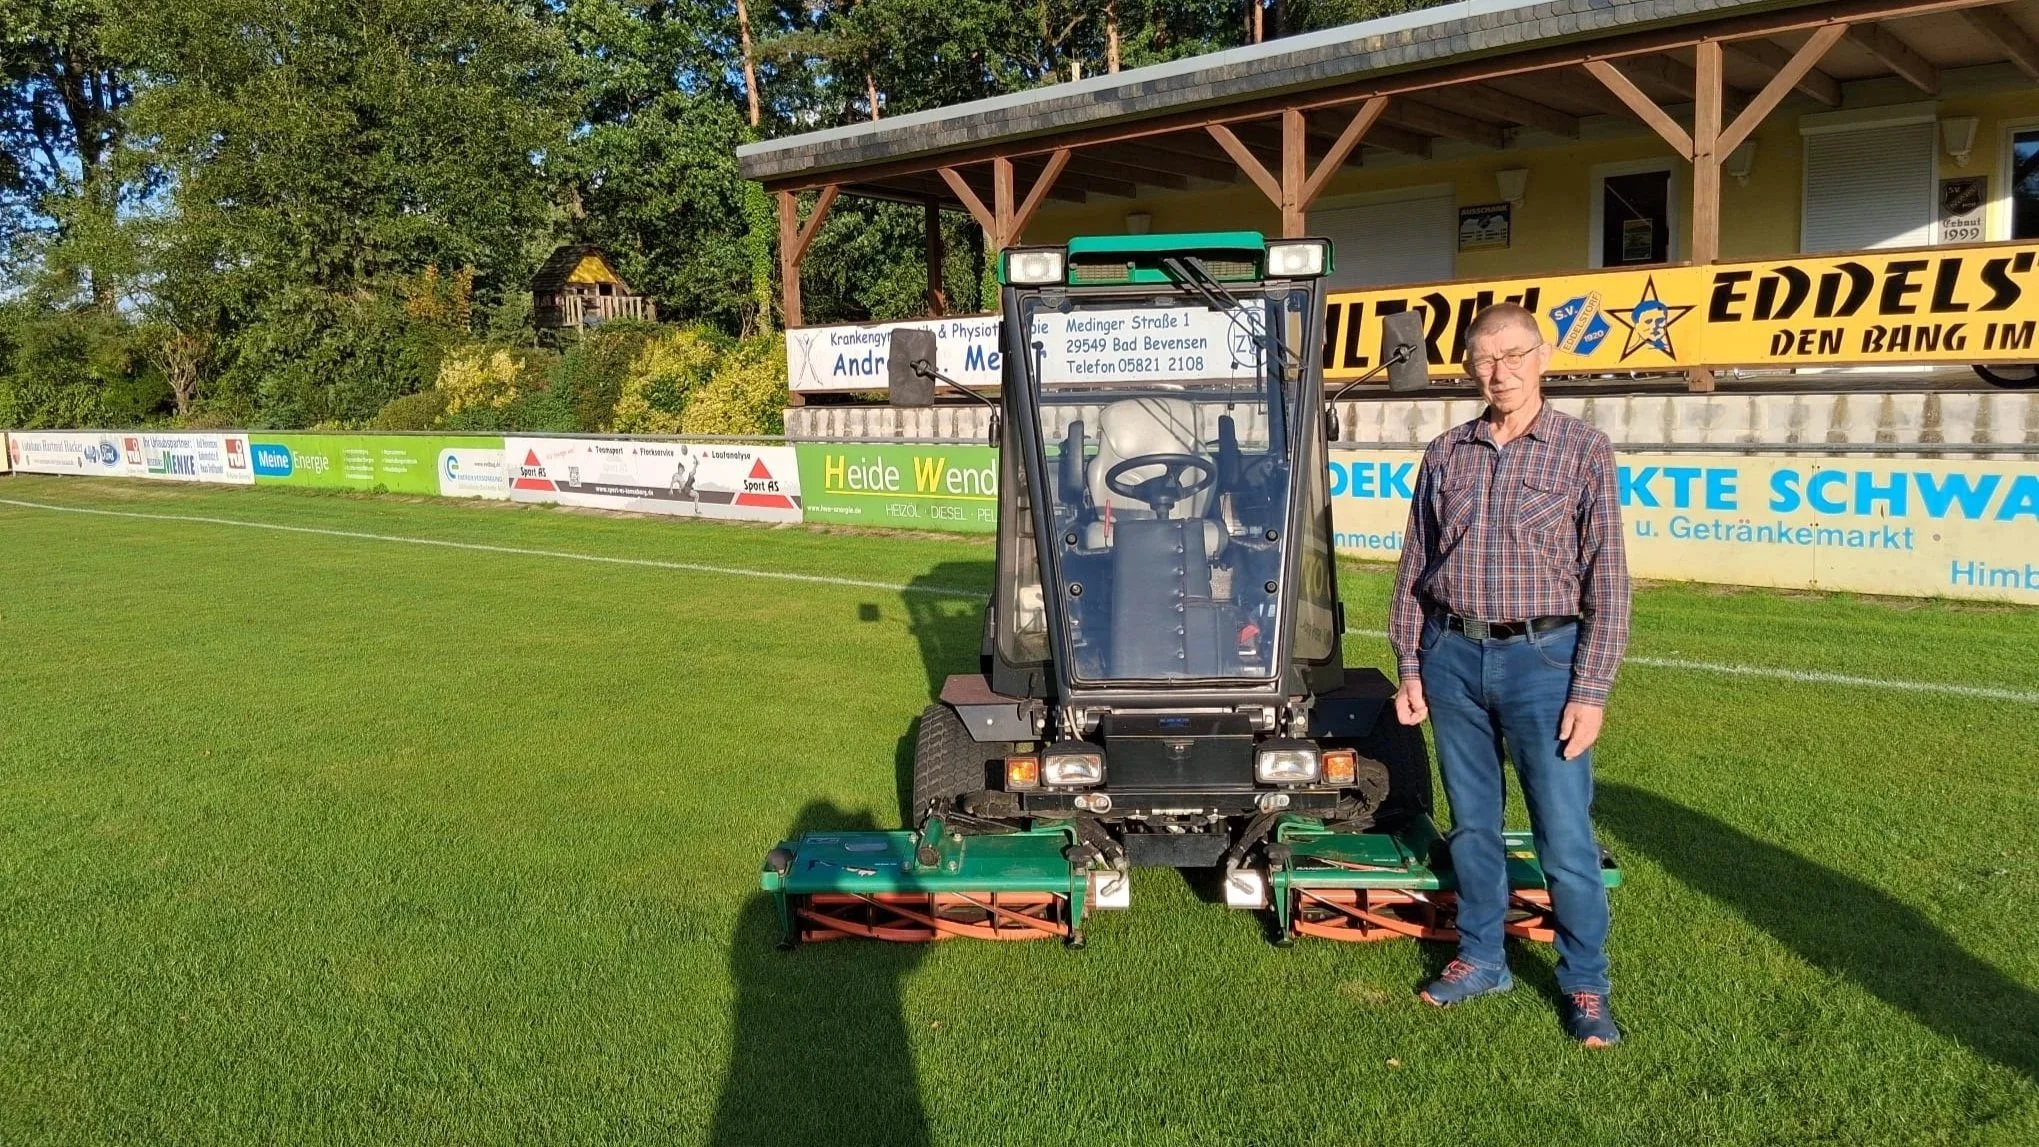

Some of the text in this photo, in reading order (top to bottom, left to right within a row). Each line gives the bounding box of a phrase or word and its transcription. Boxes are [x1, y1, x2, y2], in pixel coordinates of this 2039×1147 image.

[1943, 228, 1980, 241] 1999
[1065, 312, 1190, 335] Medinger Straße 1
[1554, 306, 1578, 321] S.V.
[1562, 292, 1600, 351] EDDELSTORF
[938, 323, 948, 339] &
[952, 319, 1049, 343] Physiotpie
[1583, 330, 1604, 342] 1920
[1770, 327, 1844, 356] DEN
[1861, 322, 1967, 354] BANG
[1066, 336, 1208, 354] 29549 Bad Bevensen
[1066, 357, 1204, 374] Telefon 05821 2108
[163, 450, 195, 475] MENKE
[257, 450, 290, 469] Meine
[293, 451, 330, 475] Energie
[595, 446, 751, 461] Teamsport Flockservice Laufanalyse
[520, 466, 547, 478] Sport AS
[825, 455, 998, 495] Heide Wend
[743, 480, 779, 492] Sport AS
[1618, 466, 1738, 511] KTE
[1768, 468, 2039, 522] SCHWA
[886, 502, 921, 518] HEIZÖL
[930, 506, 967, 520] DIESEL
[1634, 517, 1658, 537] u.
[1668, 514, 1914, 550] Getränkemarkt
[1951, 559, 2039, 591] Himb
